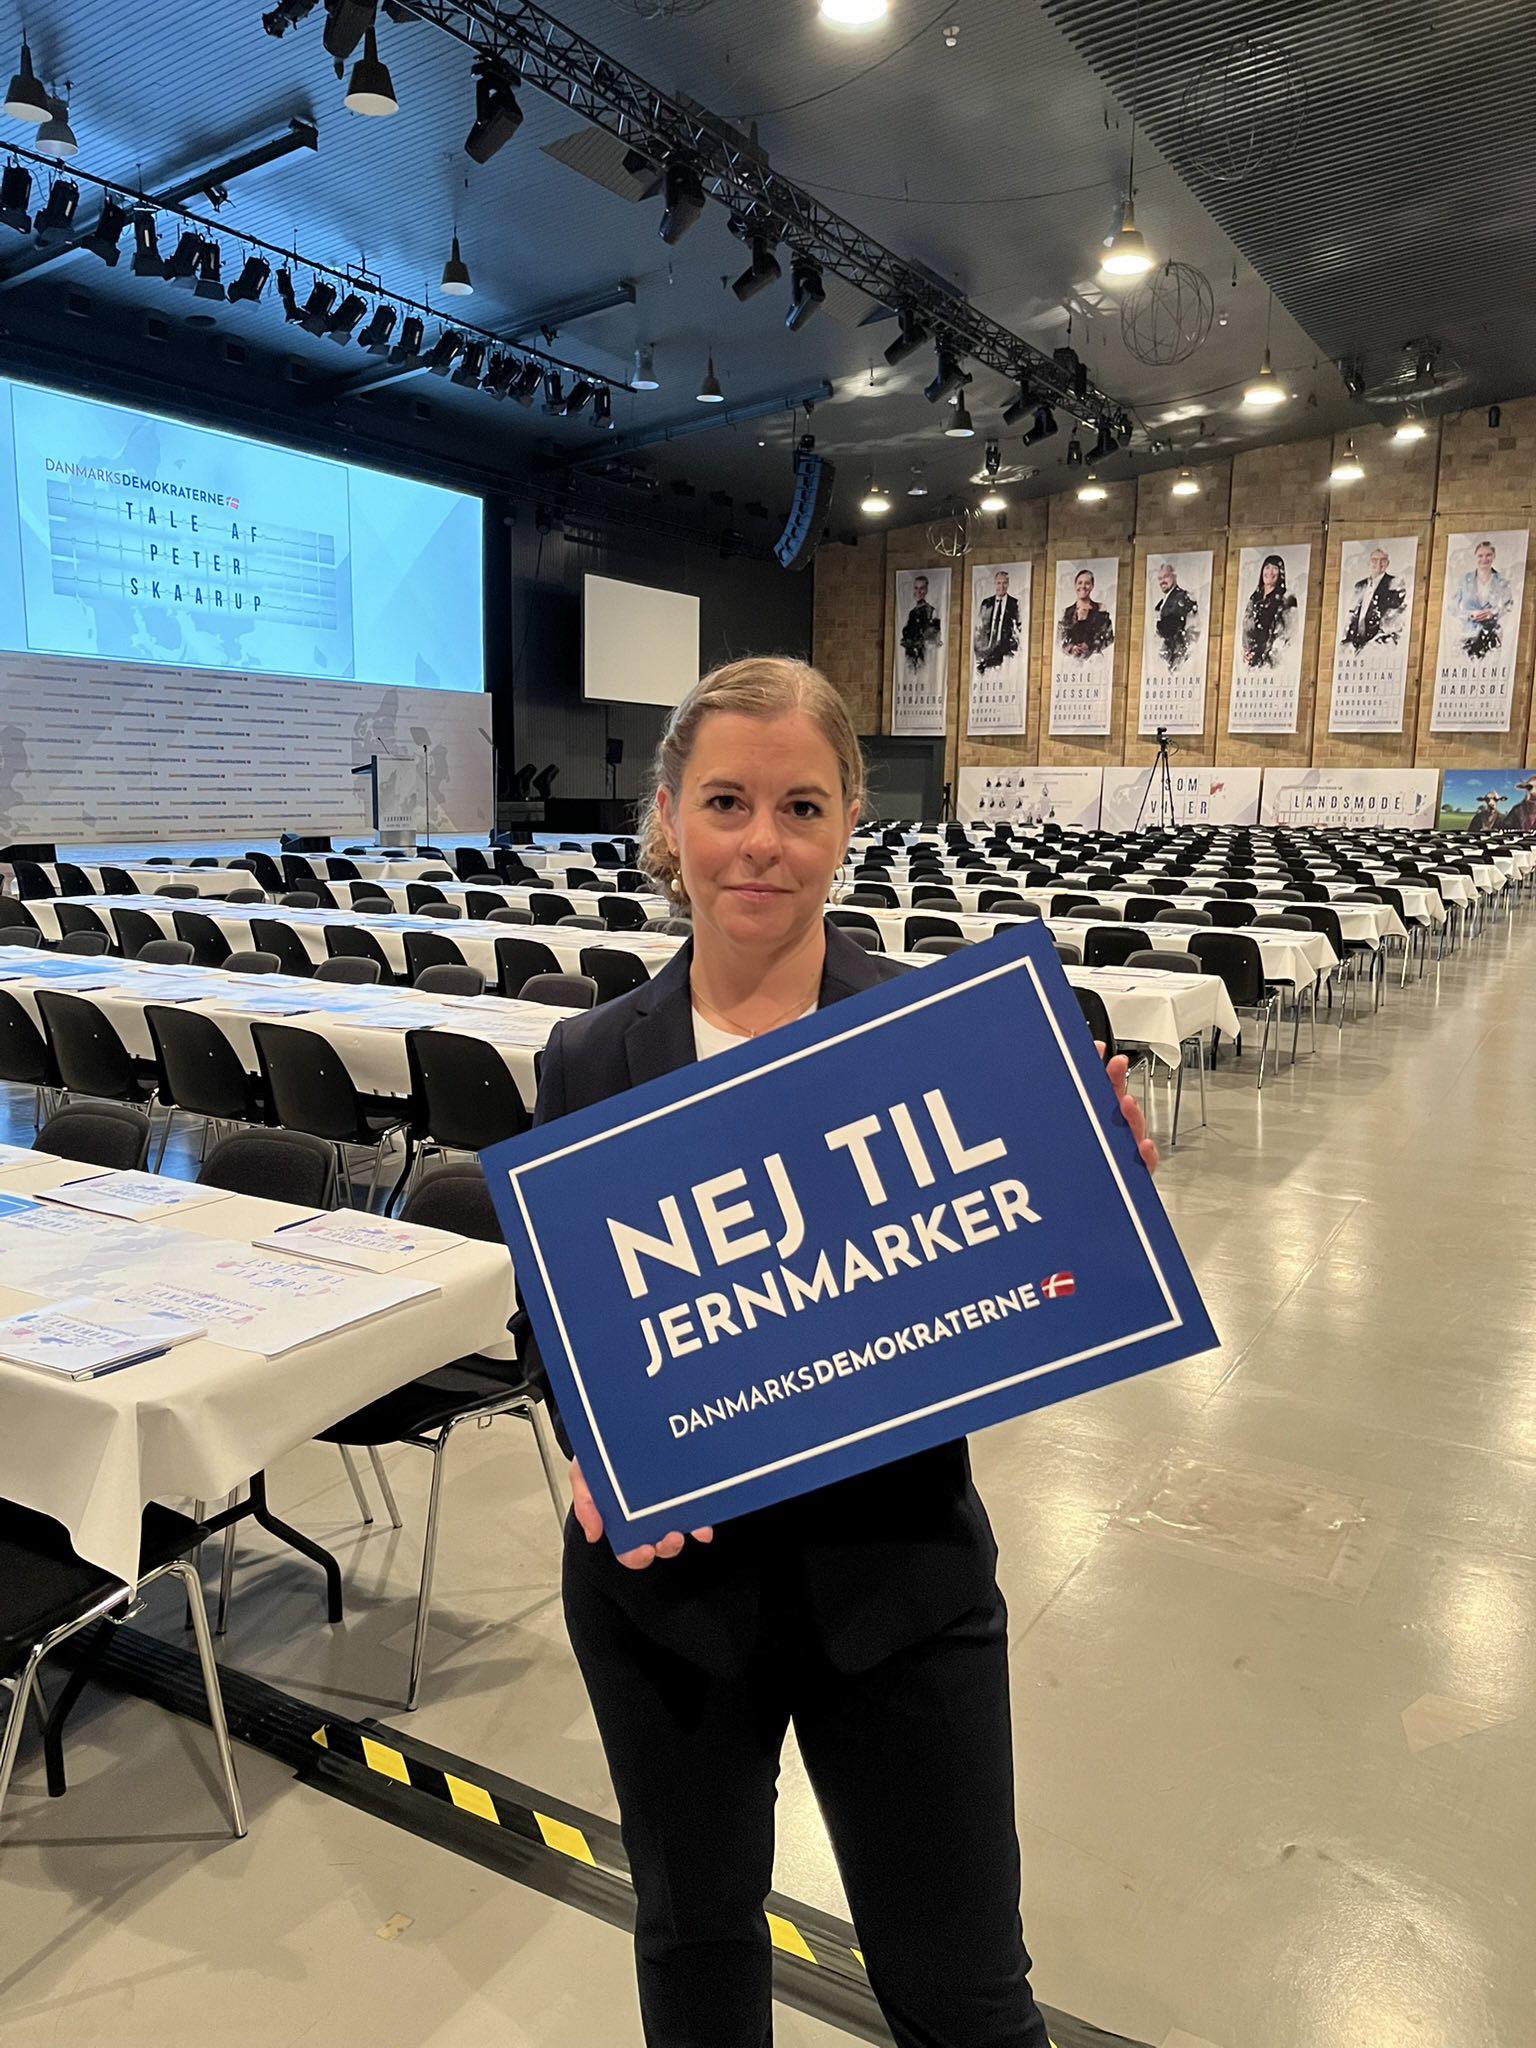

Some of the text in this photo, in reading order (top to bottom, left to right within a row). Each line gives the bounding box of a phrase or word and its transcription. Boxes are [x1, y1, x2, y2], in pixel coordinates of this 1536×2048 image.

[45, 457, 225, 506] DANMARKSDEMOKRATERNE
[125, 501, 258, 543] TALE AF
[150, 543, 241, 576] PETER
[130, 577, 261, 612] SKAARUP
[1055, 673, 1092, 683] SUSIE
[1145, 676, 1201, 686] KRISTIAN
[1441, 666, 1506, 678] MARLENE
[1055, 688, 1099, 699] JESSEN
[1440, 683, 1505, 695] HARPSØE
[1165, 777, 1198, 791] SOM
[1188, 801, 1207, 814] ER
[606, 1088, 1008, 1299] NEJ TIL
[640, 1179, 1042, 1378] JERNMARKER
[668, 1282, 1041, 1439] DANMARKSDEMOKRATERNE
